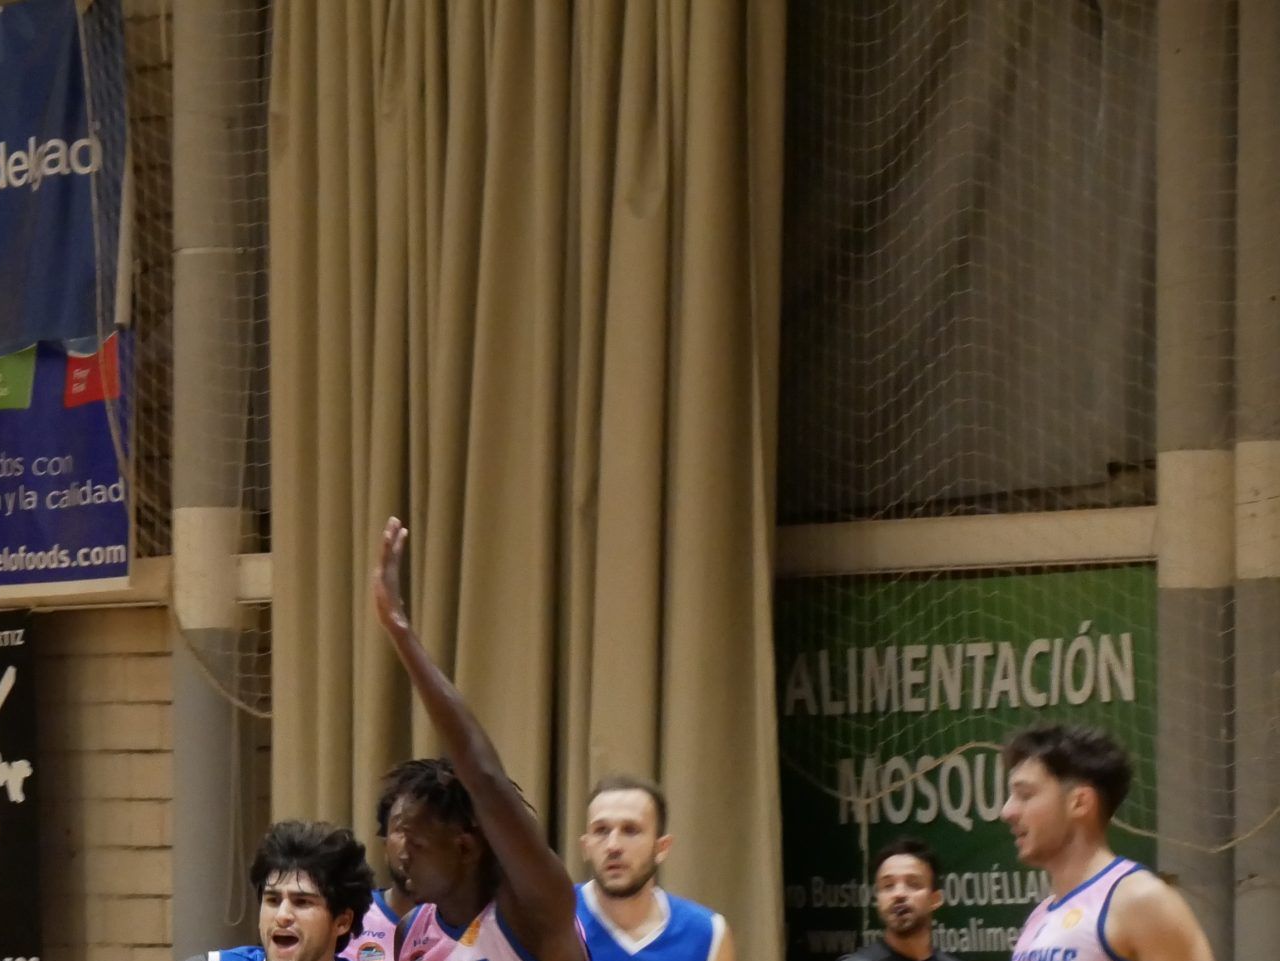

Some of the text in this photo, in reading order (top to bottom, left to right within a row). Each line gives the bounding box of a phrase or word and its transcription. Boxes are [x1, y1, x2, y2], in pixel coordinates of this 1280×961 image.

[31, 454, 74, 477] con
[4, 492, 16, 516] y
[19, 484, 38, 510] la
[45, 476, 125, 511] calidad
[784, 619, 1136, 717] ALIMENTACIÓN
[838, 752, 1004, 832] MOSQU
